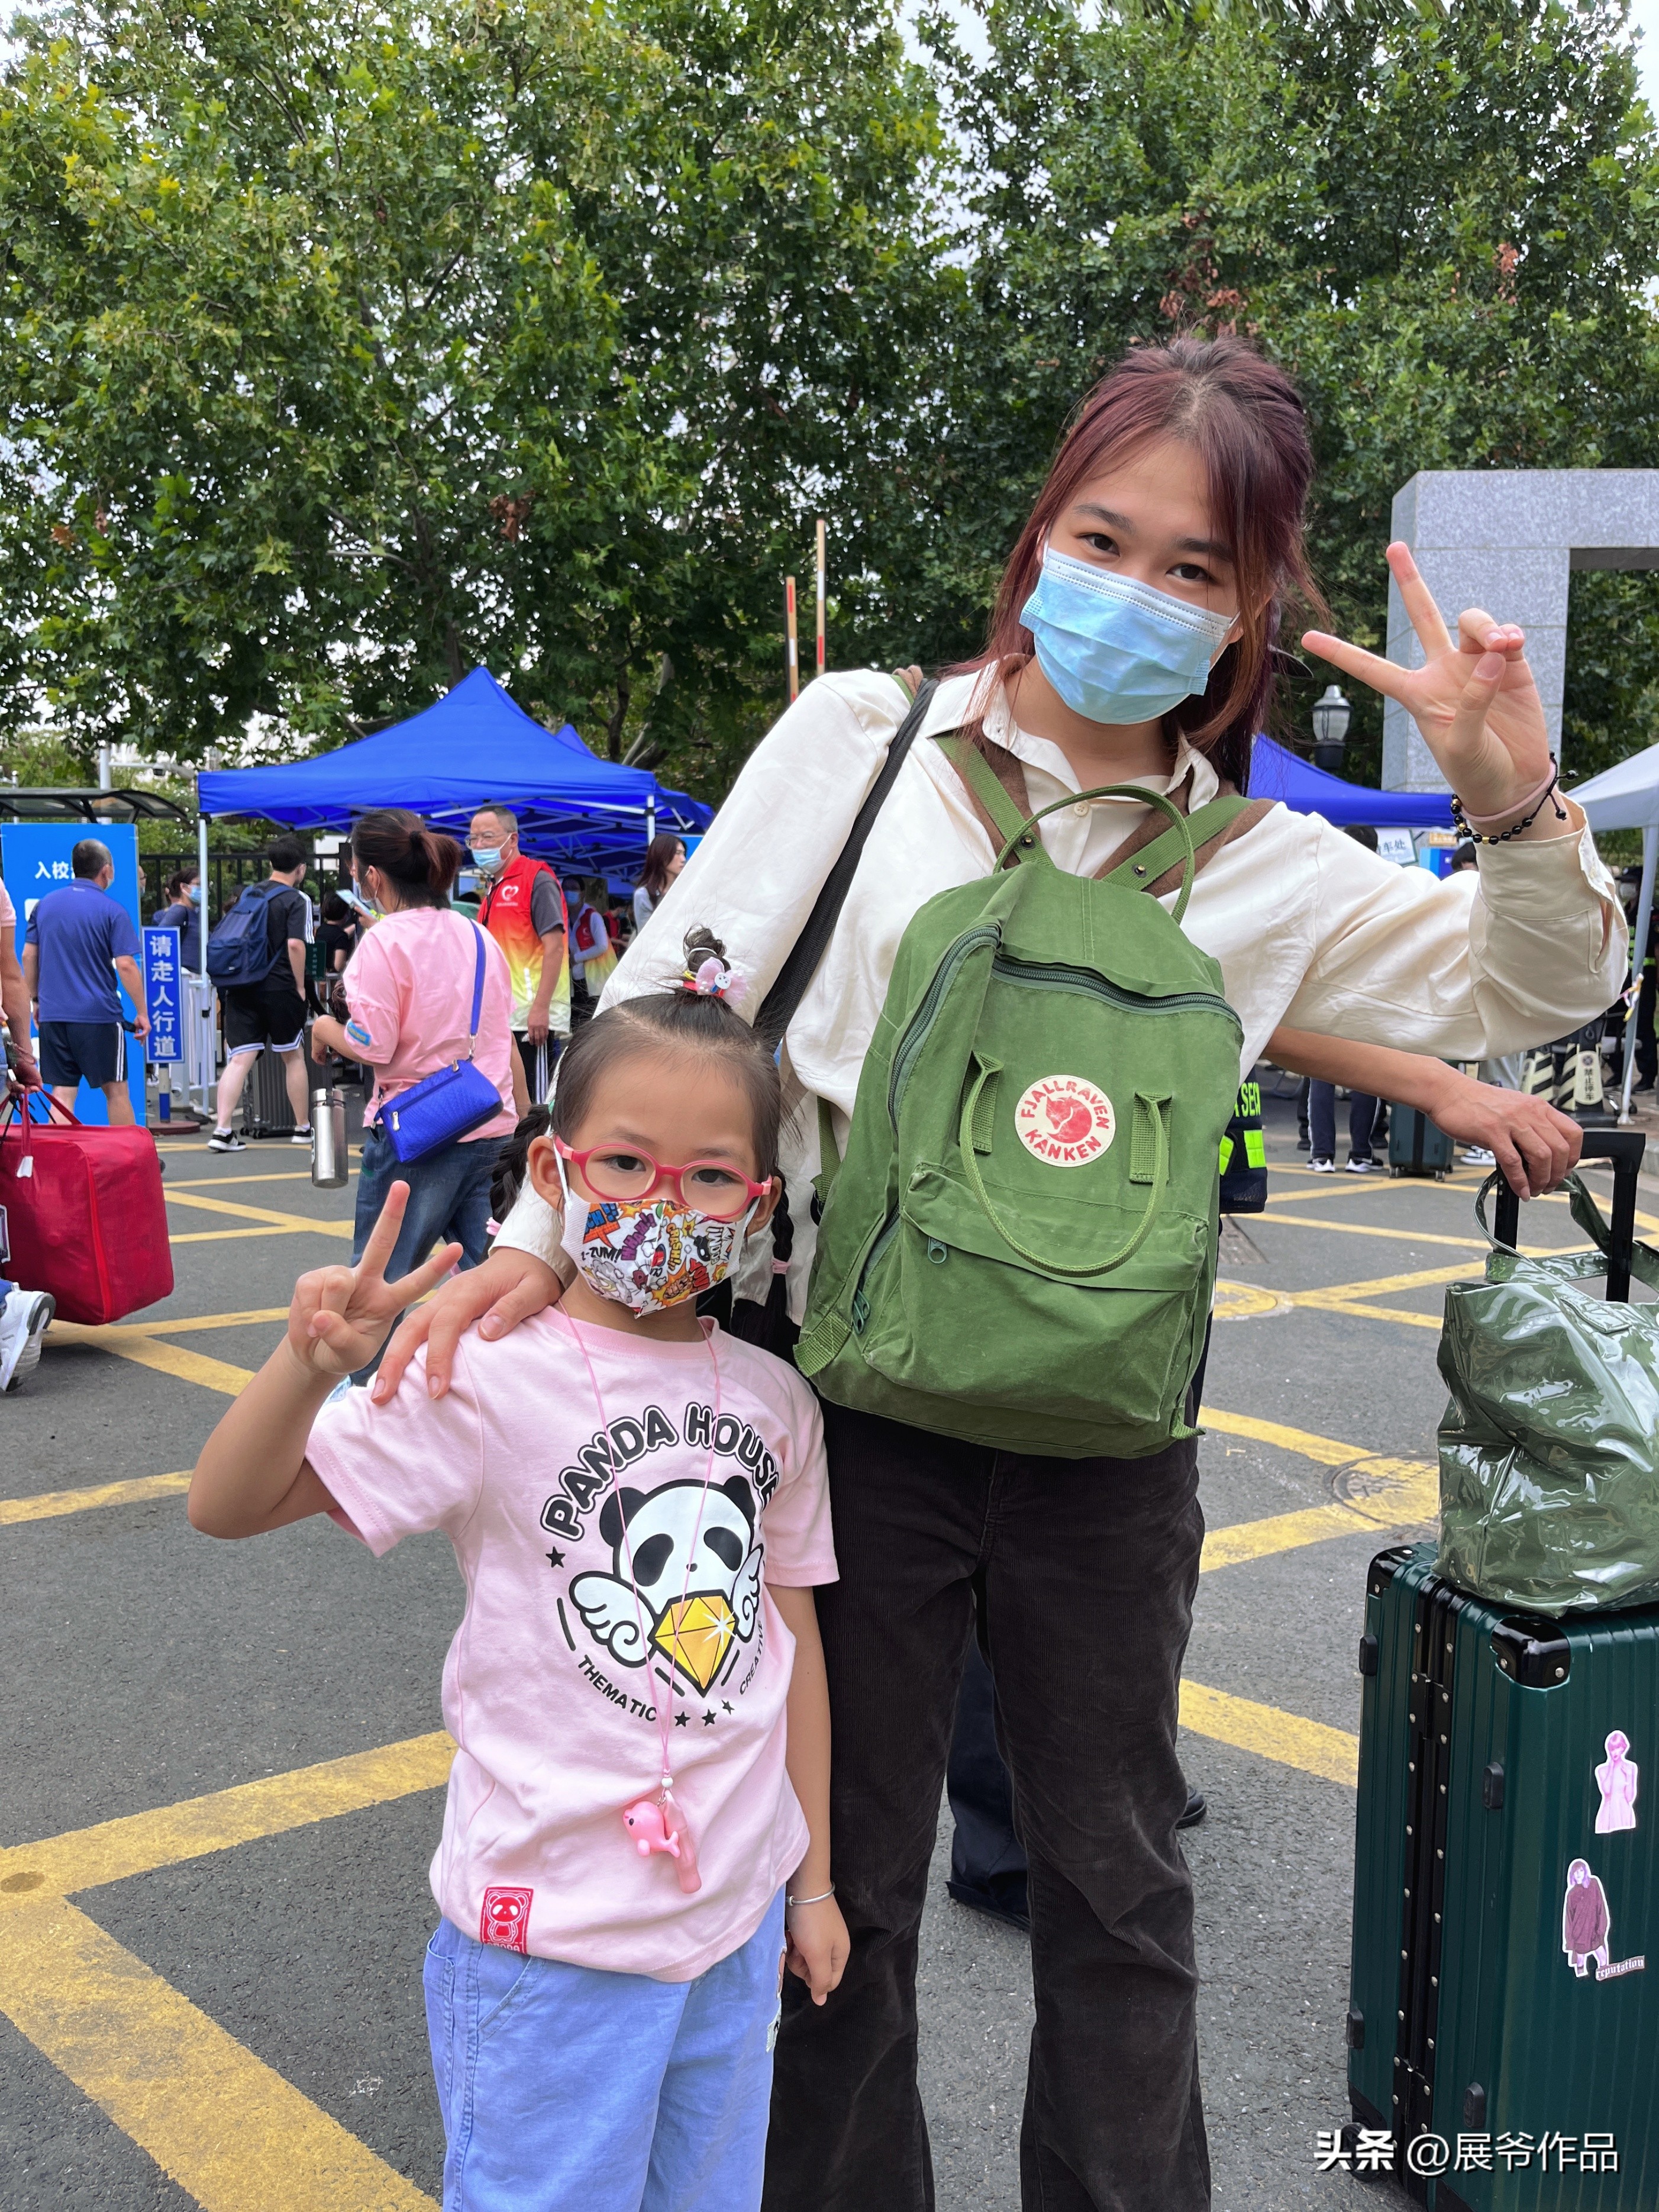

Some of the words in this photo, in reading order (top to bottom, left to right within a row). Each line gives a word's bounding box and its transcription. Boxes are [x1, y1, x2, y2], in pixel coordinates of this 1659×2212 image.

[34, 861, 76, 880] 入校
[149, 934, 177, 1057] 请走人行道
[540, 1404, 680, 1542] PANDA
[683, 1401, 779, 1514] HOUSE
[578, 1654, 657, 1721] THEMATIC
[1596, 1959, 1644, 1981] reputation
